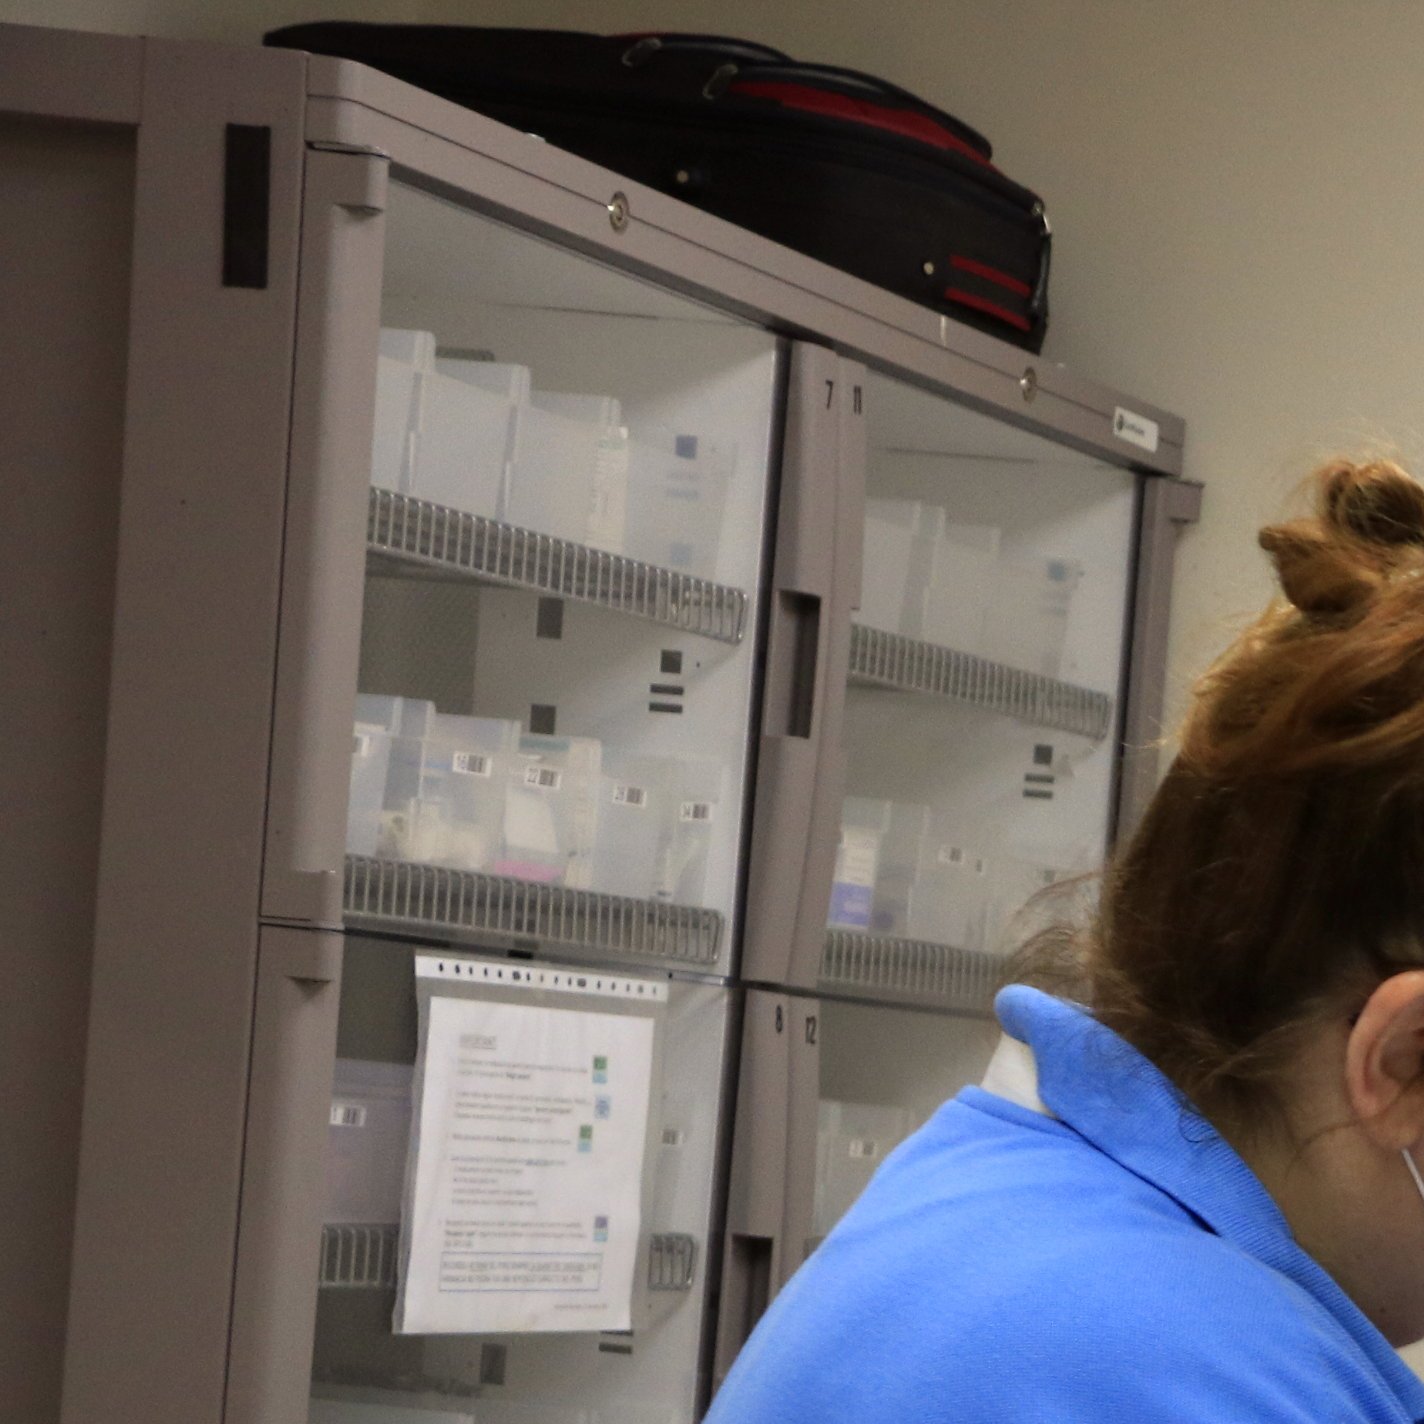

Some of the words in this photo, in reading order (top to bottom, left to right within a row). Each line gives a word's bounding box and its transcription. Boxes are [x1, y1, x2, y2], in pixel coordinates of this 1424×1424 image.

[825, 379, 834, 410] 7
[853, 385, 862, 416] 11
[775, 1004, 783, 1034] 8
[805, 1015, 817, 1045] 12
